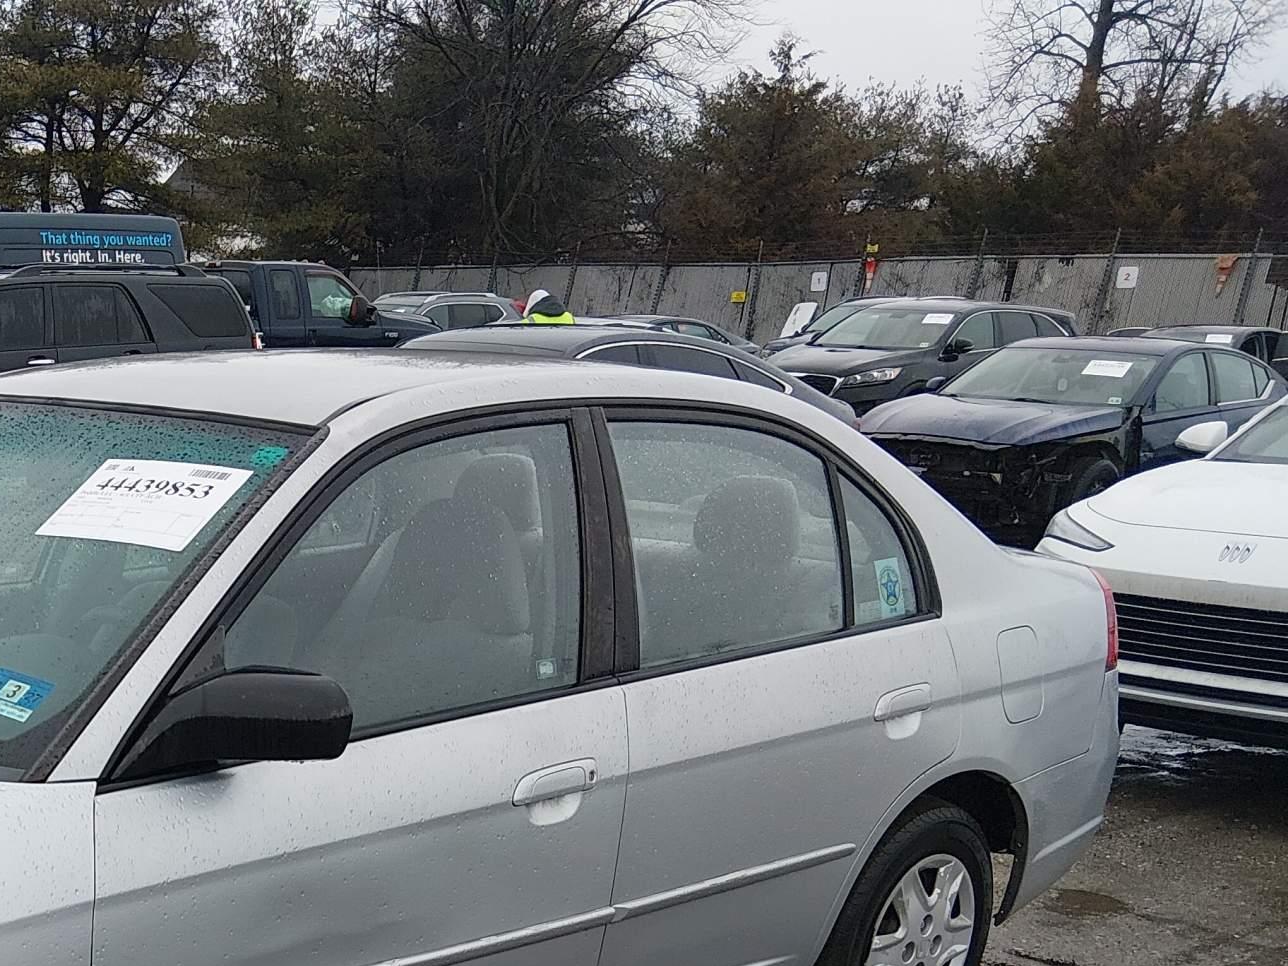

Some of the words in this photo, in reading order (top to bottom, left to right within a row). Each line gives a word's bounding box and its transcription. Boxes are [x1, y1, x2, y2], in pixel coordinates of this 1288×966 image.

[40, 231, 67, 245] That
[70, 232, 100, 248] thing
[103, 235, 124, 249] you
[127, 234, 172, 247] wanted?
[42, 250, 61, 263] It's
[63, 250, 95, 264] right.
[98, 250, 113, 263] In.
[116, 250, 145, 264] Here.
[96, 477, 215, 499] 44439853
[6, 684, 22, 698] 3
